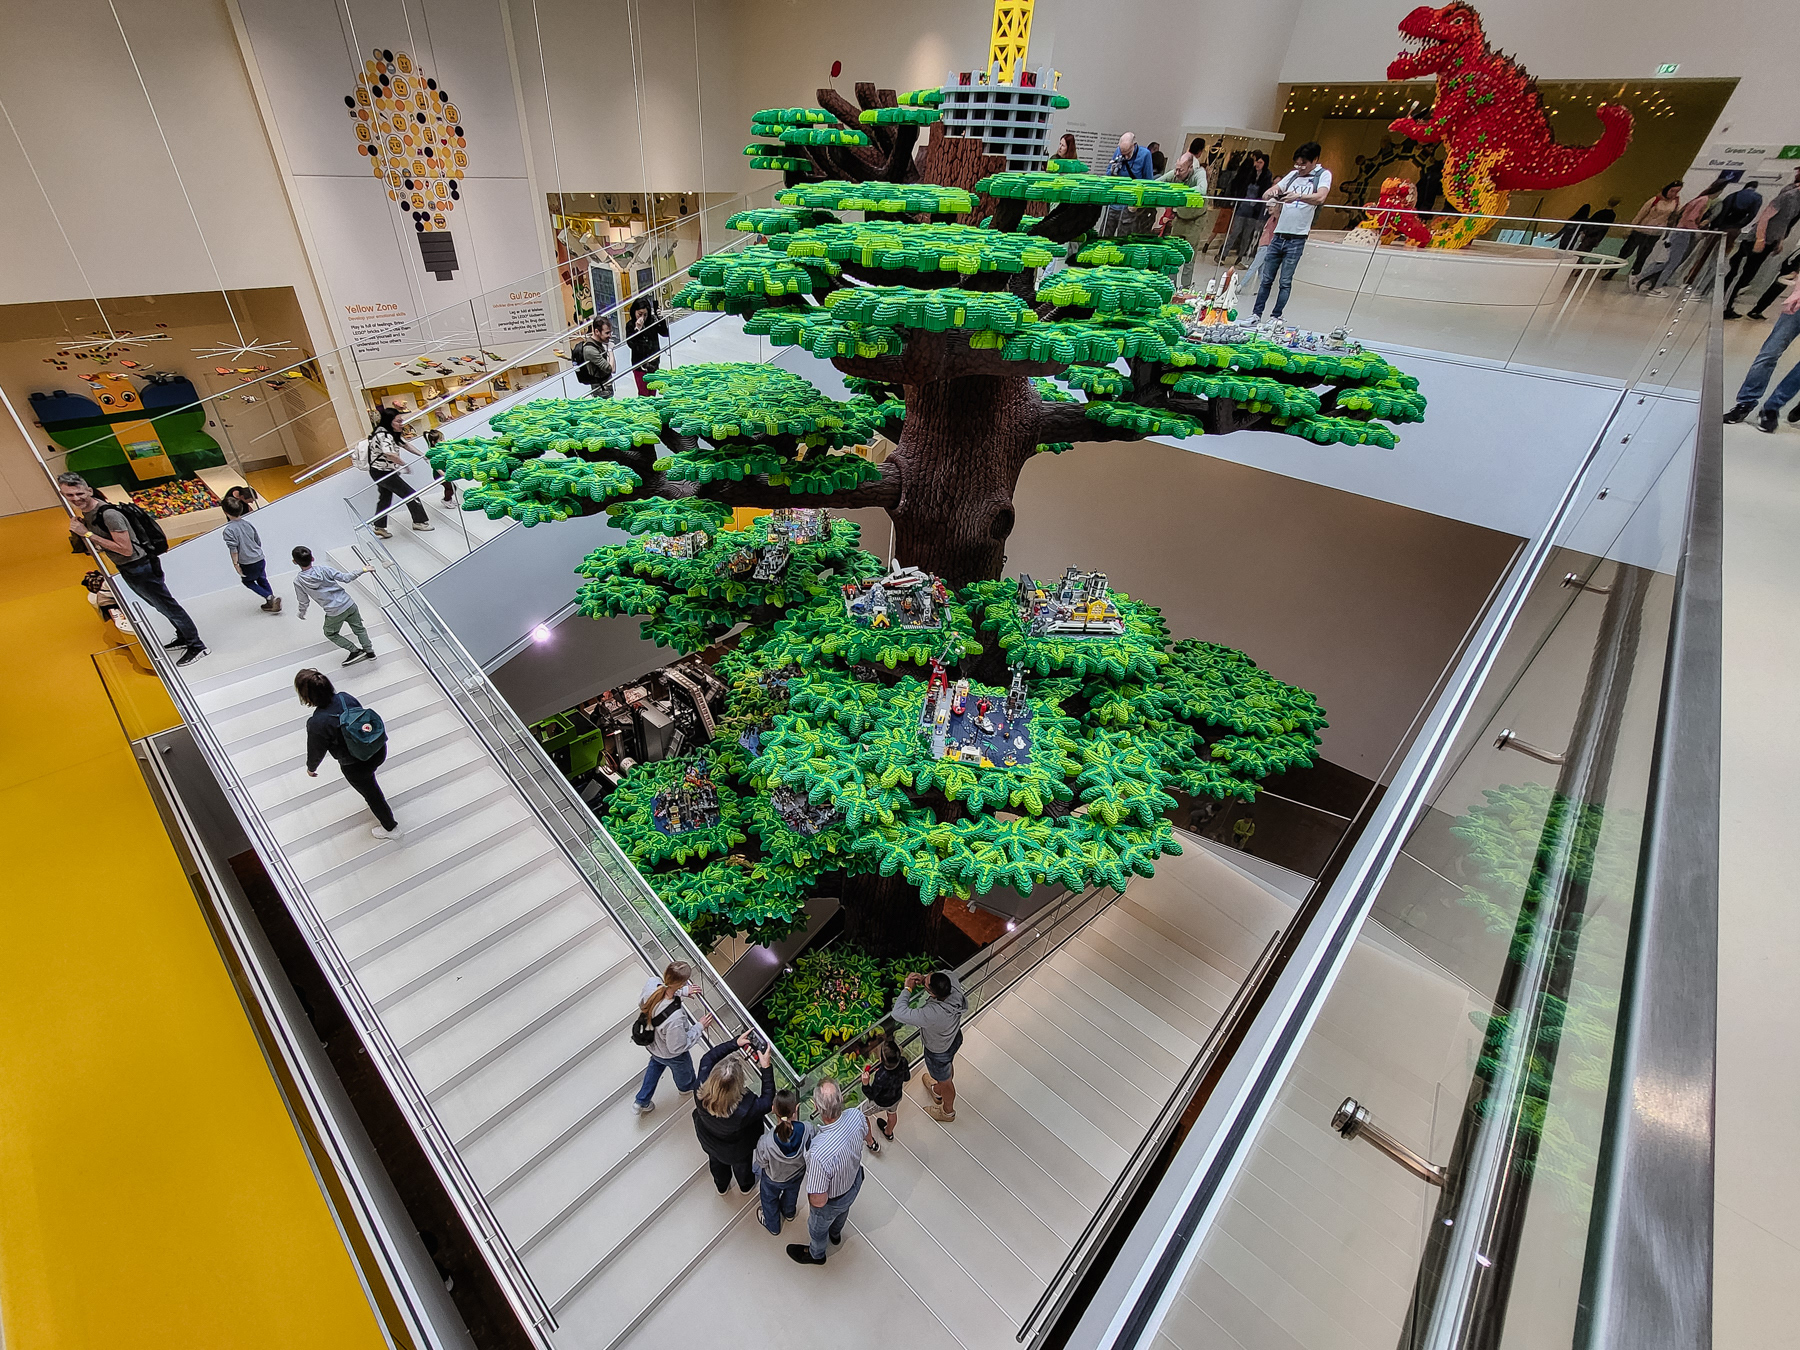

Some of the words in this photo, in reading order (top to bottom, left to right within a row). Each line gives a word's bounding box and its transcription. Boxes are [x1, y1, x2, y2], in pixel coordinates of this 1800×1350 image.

[523, 291, 541, 299] Zone
[345, 304, 374, 314] Yellow
[376, 303, 398, 311] Zone
